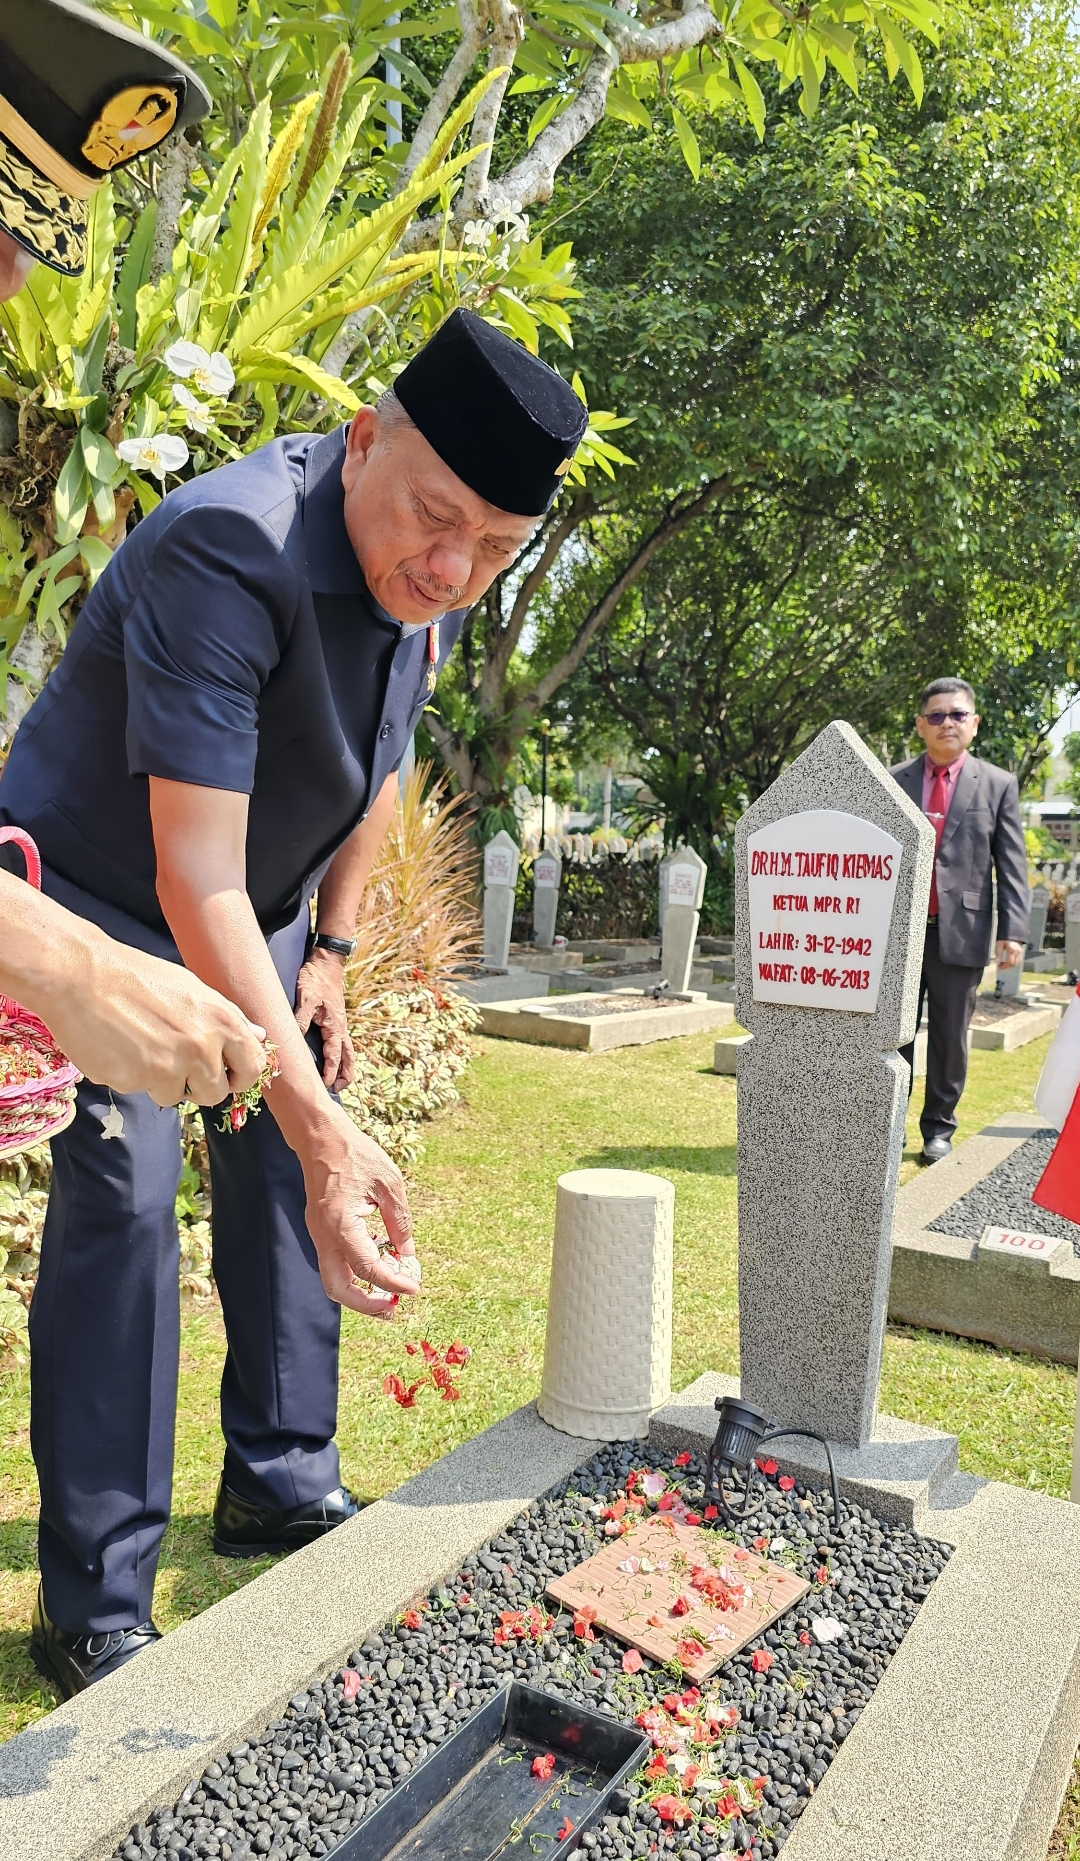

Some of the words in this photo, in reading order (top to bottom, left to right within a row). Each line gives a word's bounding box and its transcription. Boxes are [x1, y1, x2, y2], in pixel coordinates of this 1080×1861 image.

[794, 851, 839, 881] TAUFIQ
[841, 853, 893, 881] KIEMAS
[772, 894, 809, 912] KETUA
[813, 895, 842, 914] MPR
[845, 896, 861, 914] RI
[759, 931, 799, 951] LAHIR:
[804, 933, 872, 956] 31-12-1942
[758, 962, 798, 983] WAFAT:
[800, 966, 870, 990] 08-06-2013
[998, 1233, 1046, 1250] 100
